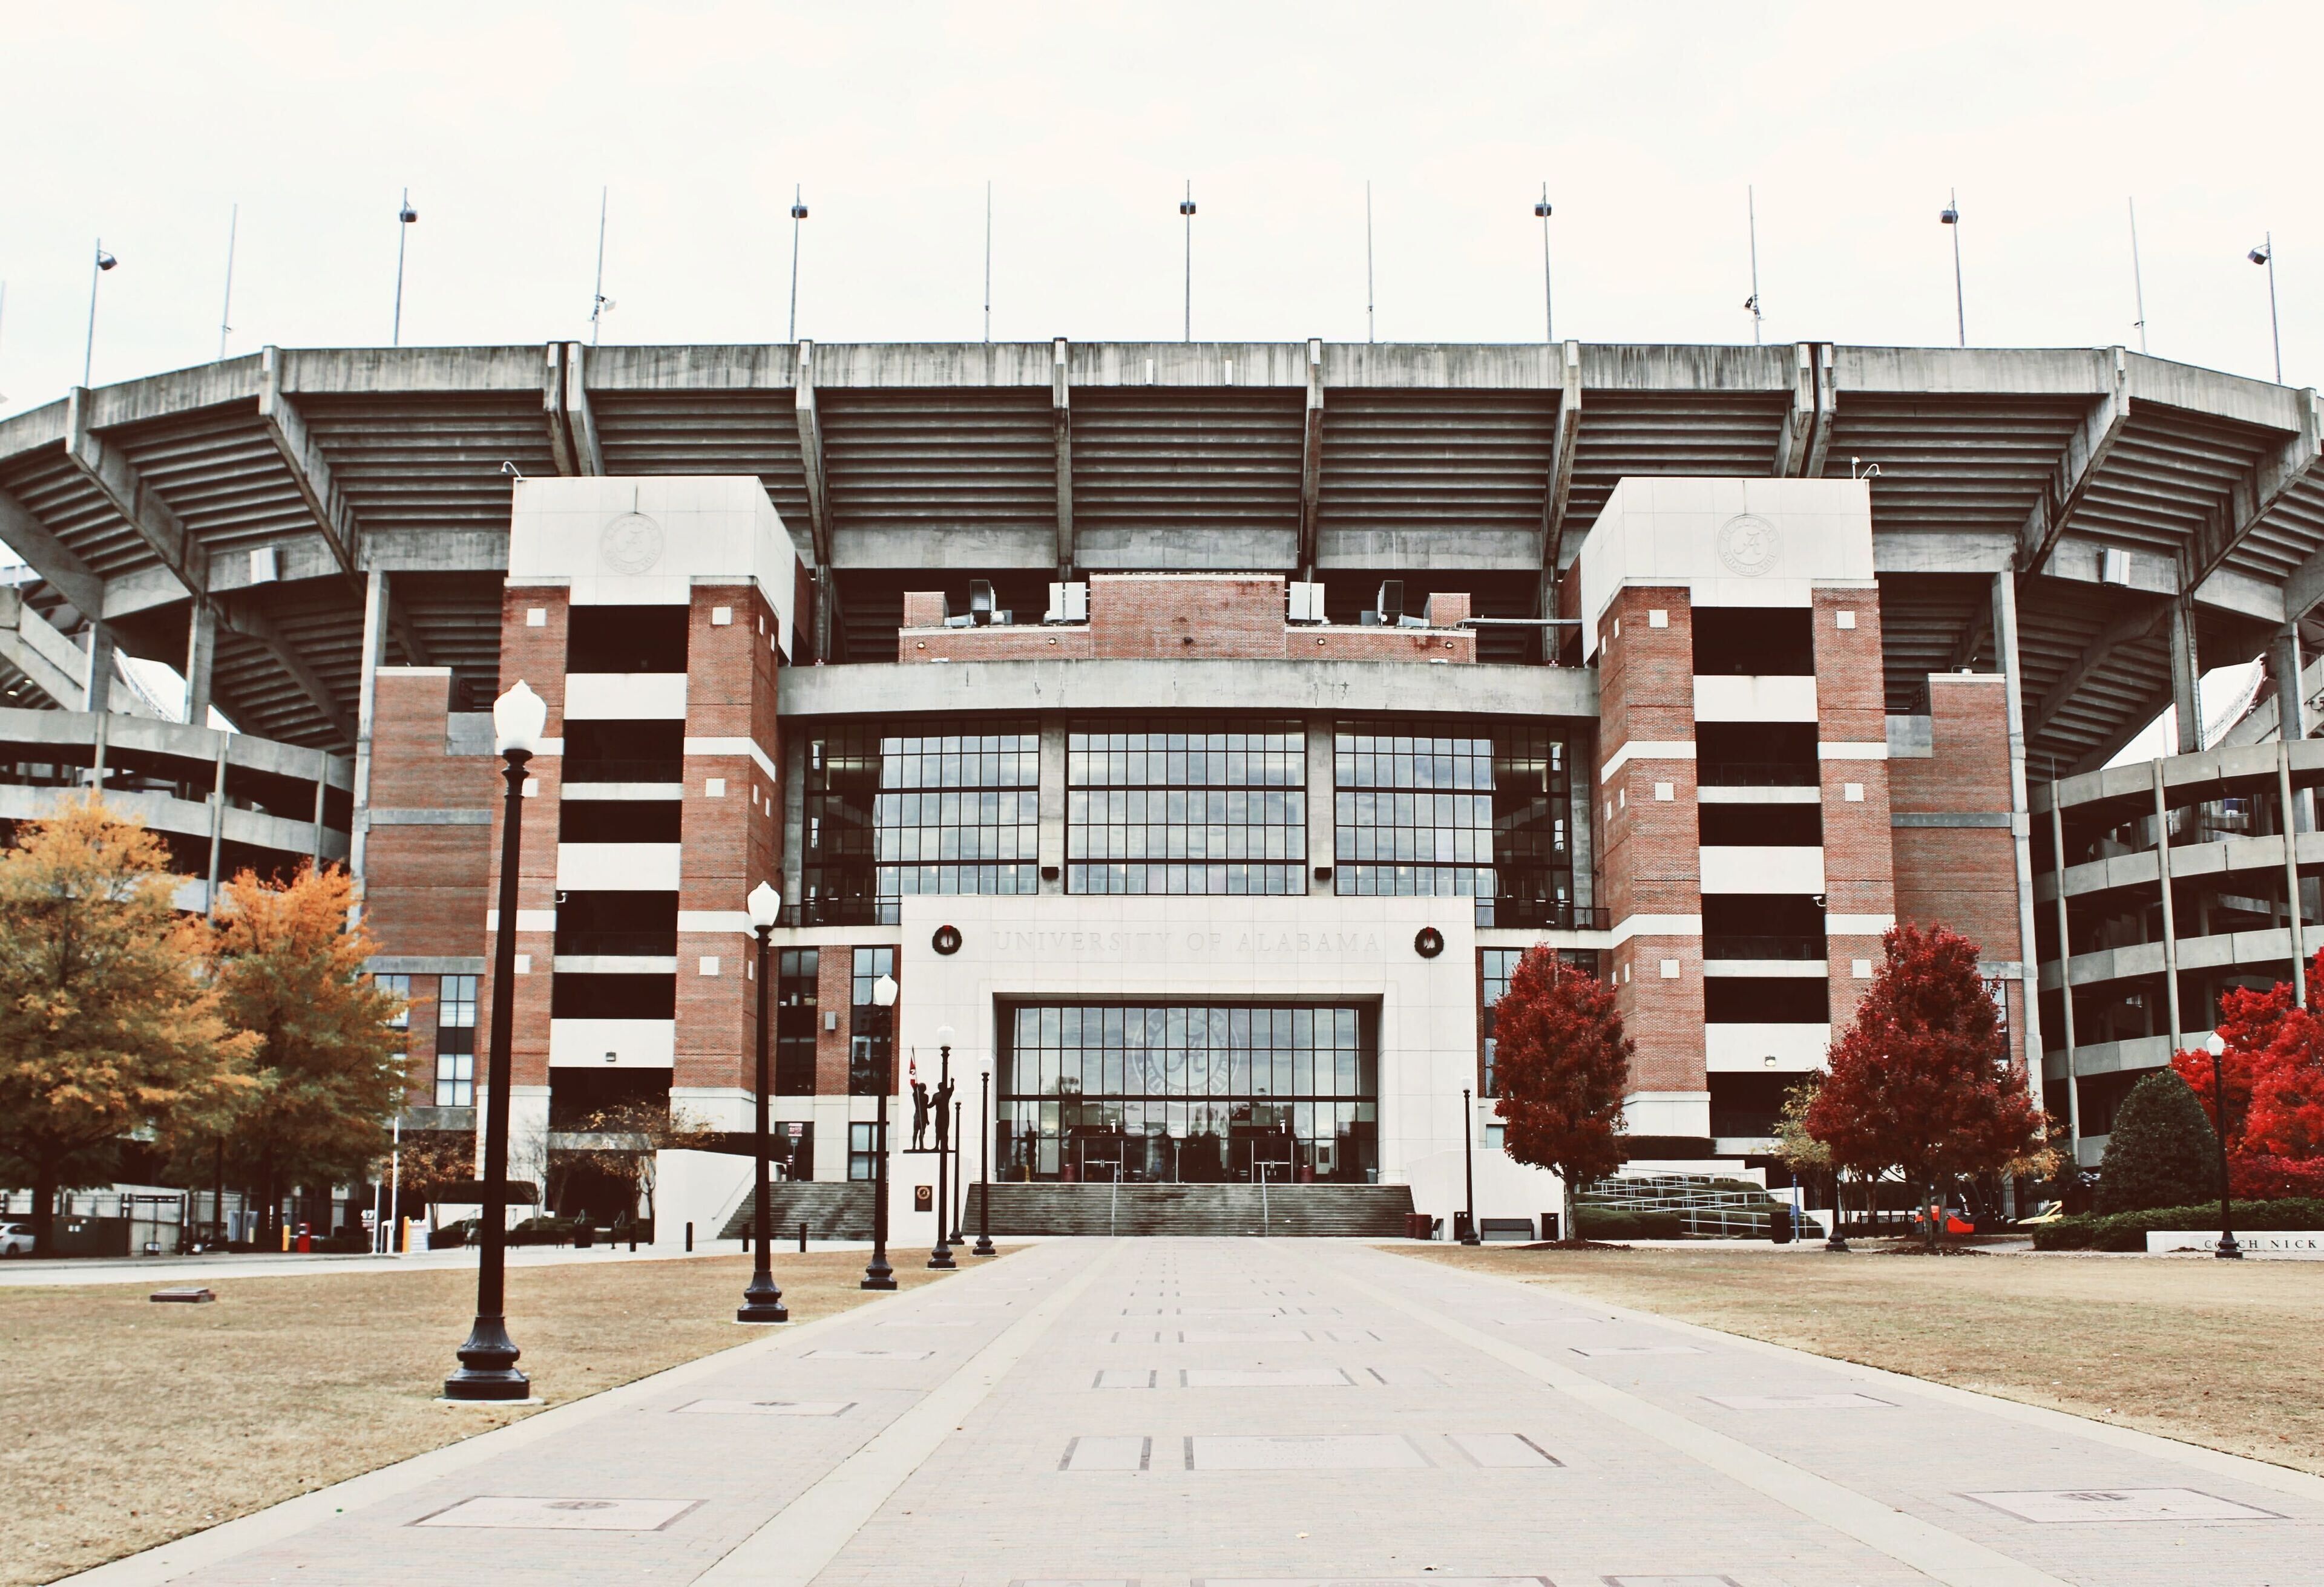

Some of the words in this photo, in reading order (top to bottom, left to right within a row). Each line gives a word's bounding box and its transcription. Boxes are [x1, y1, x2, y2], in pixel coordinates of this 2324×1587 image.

[993, 932, 1172, 951] UNIVERSITY
[1186, 932, 1221, 951] OF
[1236, 932, 1380, 952] ALABAMA
[1111, 1122, 1116, 1133] 1
[1280, 1122, 1285, 1134] 1
[2204, 1240, 2258, 1249] CCH
[2271, 1240, 2317, 1249] NICK
